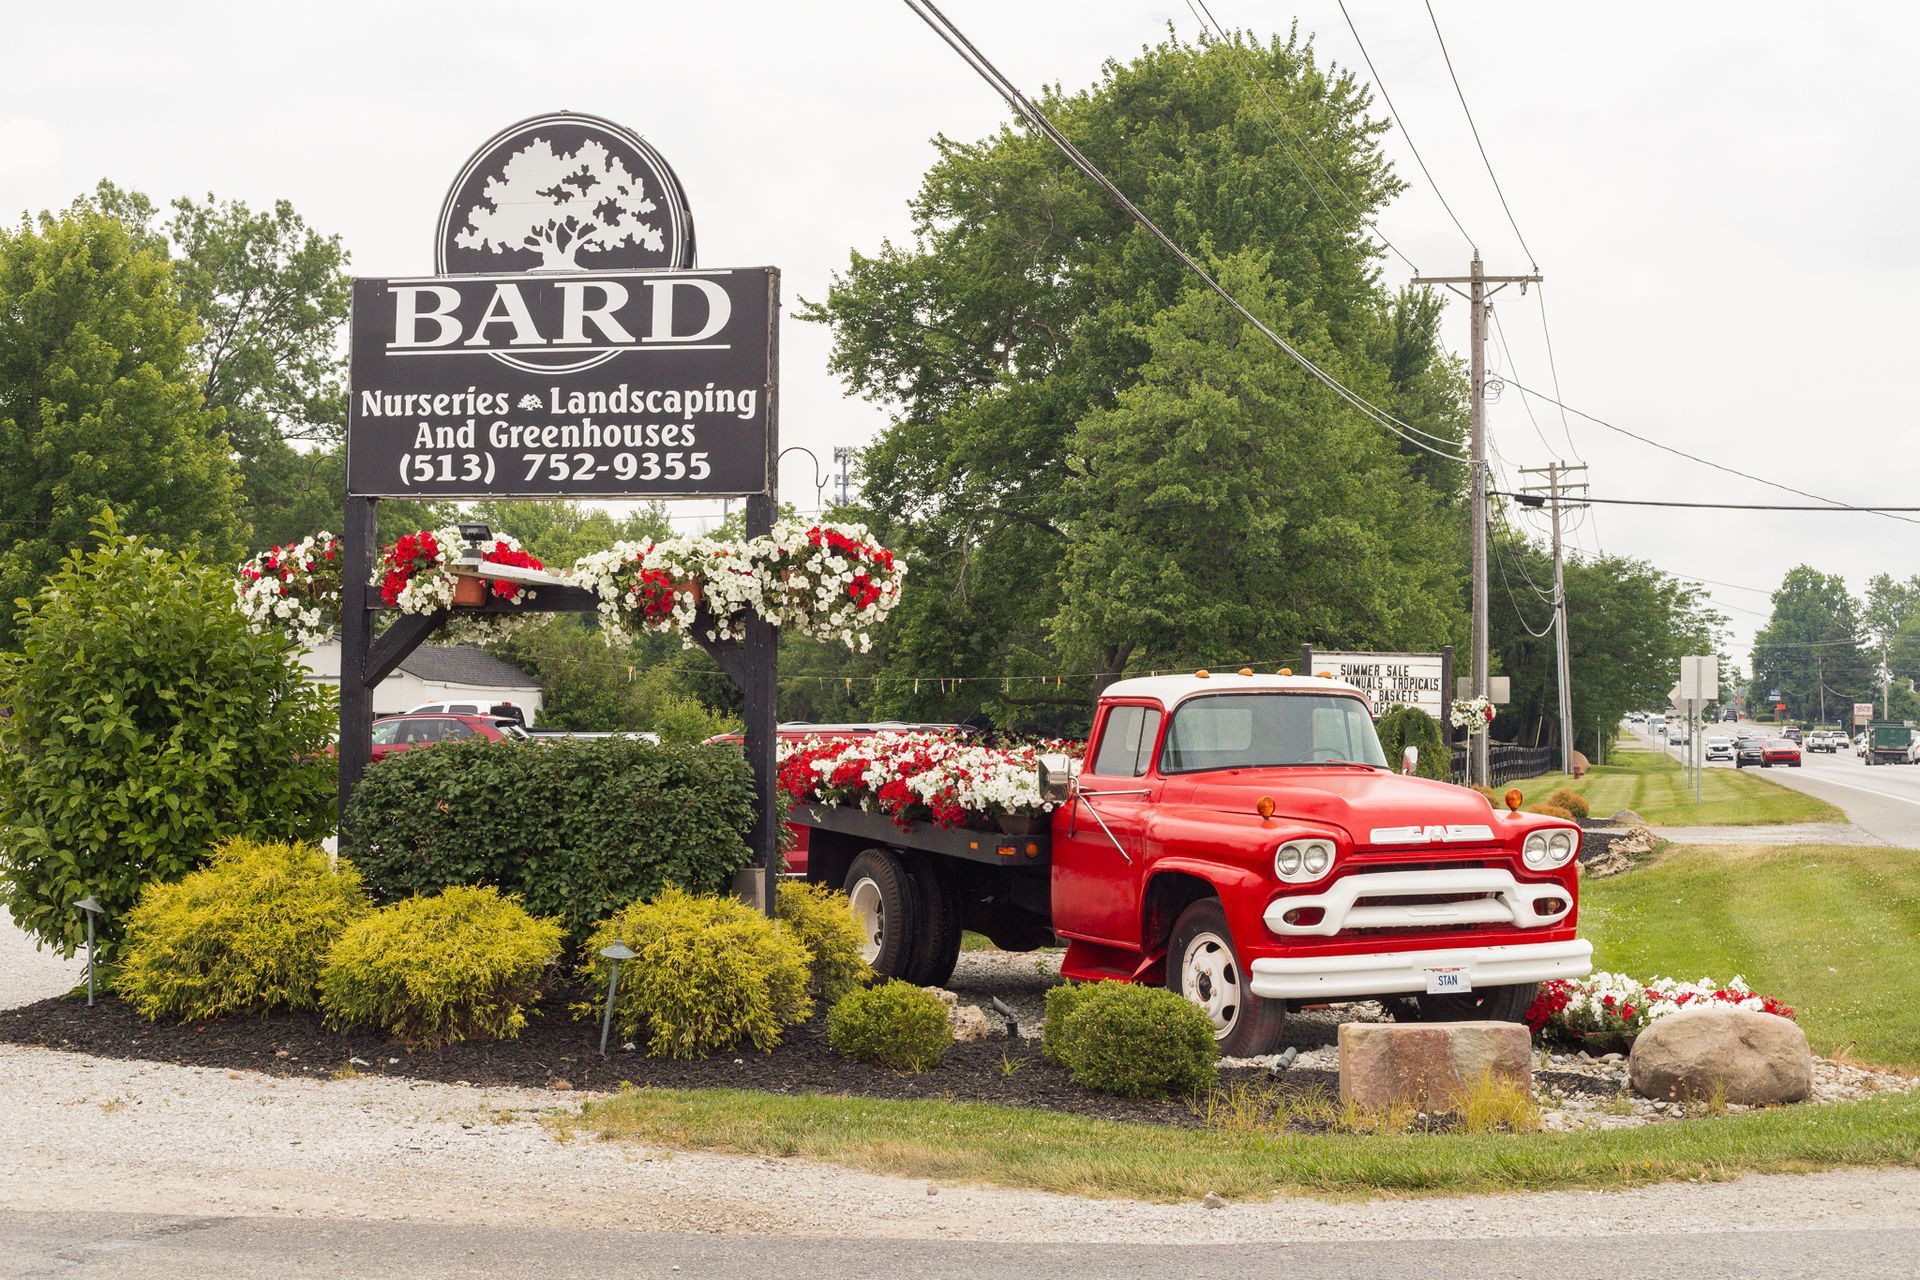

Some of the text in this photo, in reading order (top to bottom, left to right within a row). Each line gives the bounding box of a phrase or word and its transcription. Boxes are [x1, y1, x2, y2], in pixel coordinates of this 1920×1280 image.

[386, 279, 732, 348] BARD
[361, 383, 757, 420] Nurseries Landscaping
[413, 417, 696, 449] And Greenhouses
[399, 451, 711, 486] (513) 752-9355
[1340, 664, 1410, 677] SUMMER SALE
[1393, 678, 1439, 690] TROPICALS
[1379, 691, 1419, 702] BASKETS
[1438, 975, 1458, 986] STAN
